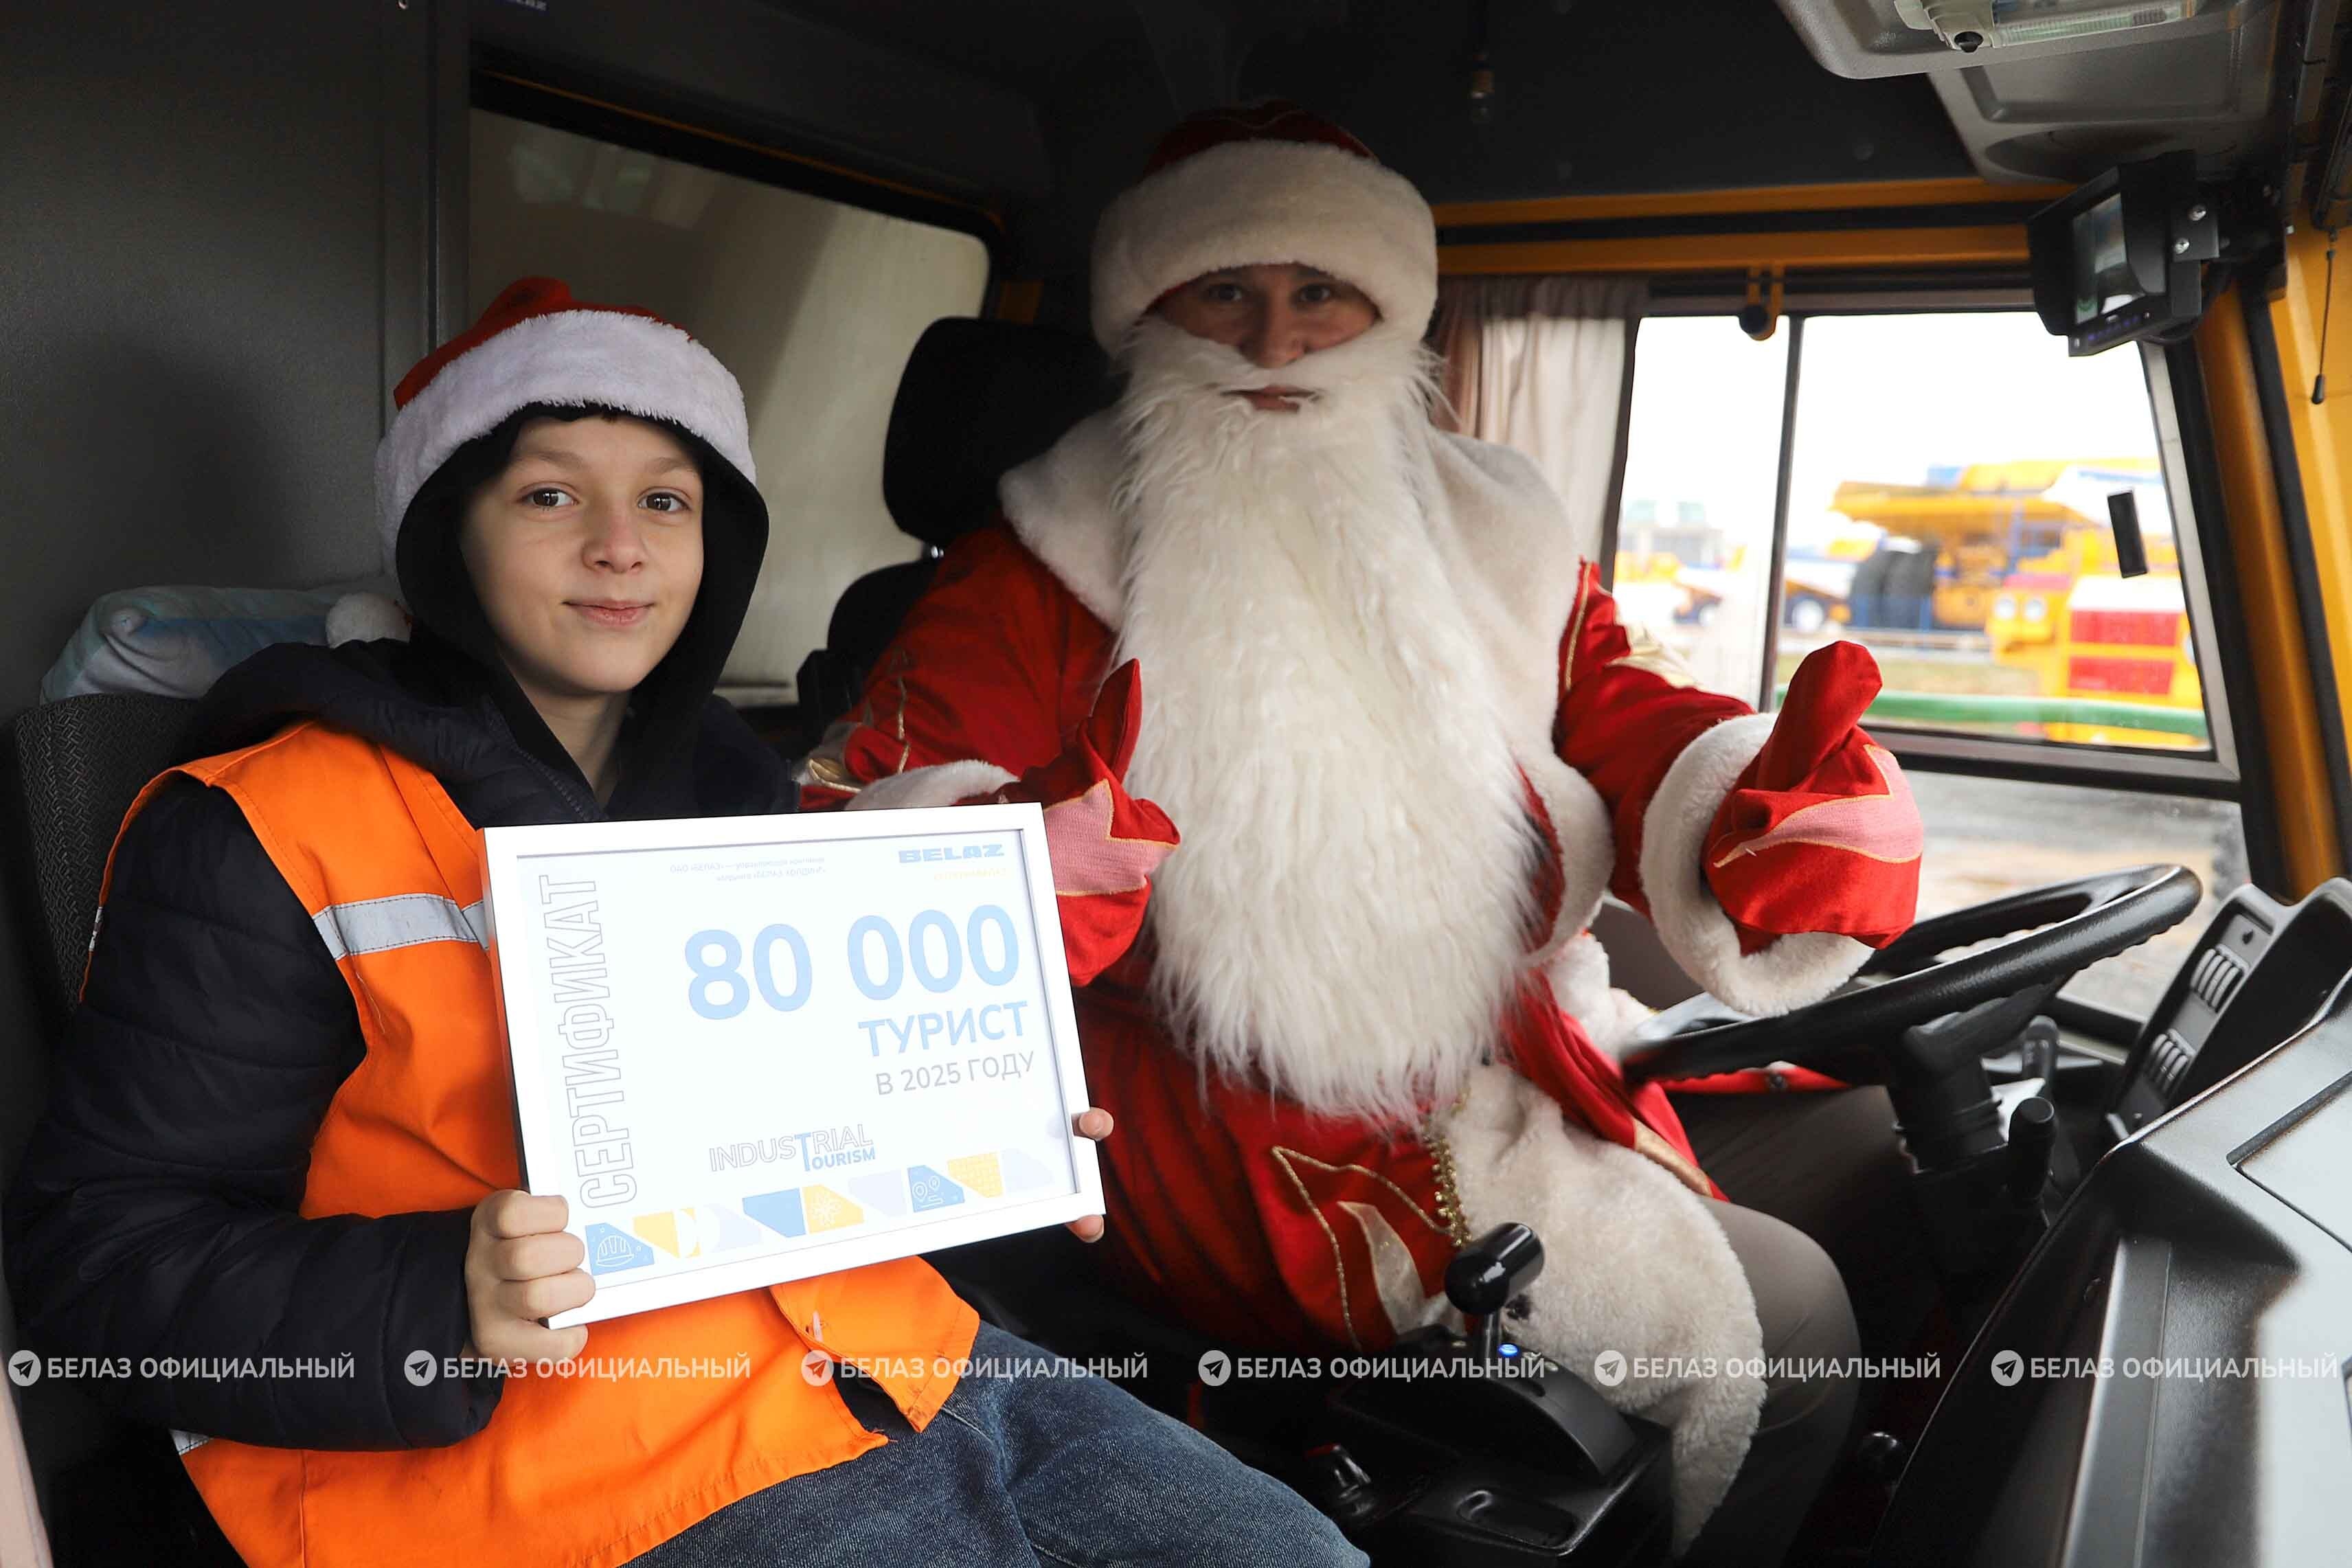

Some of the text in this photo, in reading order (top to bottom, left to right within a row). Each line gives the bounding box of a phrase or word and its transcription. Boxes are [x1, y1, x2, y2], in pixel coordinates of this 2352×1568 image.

[898, 844, 1005, 863] BELAZ
[684, 904, 1020, 1021] 80 000
[539, 874, 637, 1209] СЕРТИФИКАТ
[858, 1001, 1028, 1057] ТУРИСТ
[876, 1051, 1034, 1095] В 2025 ГОДУ
[709, 1124, 874, 1172] INDUSTRIAL
